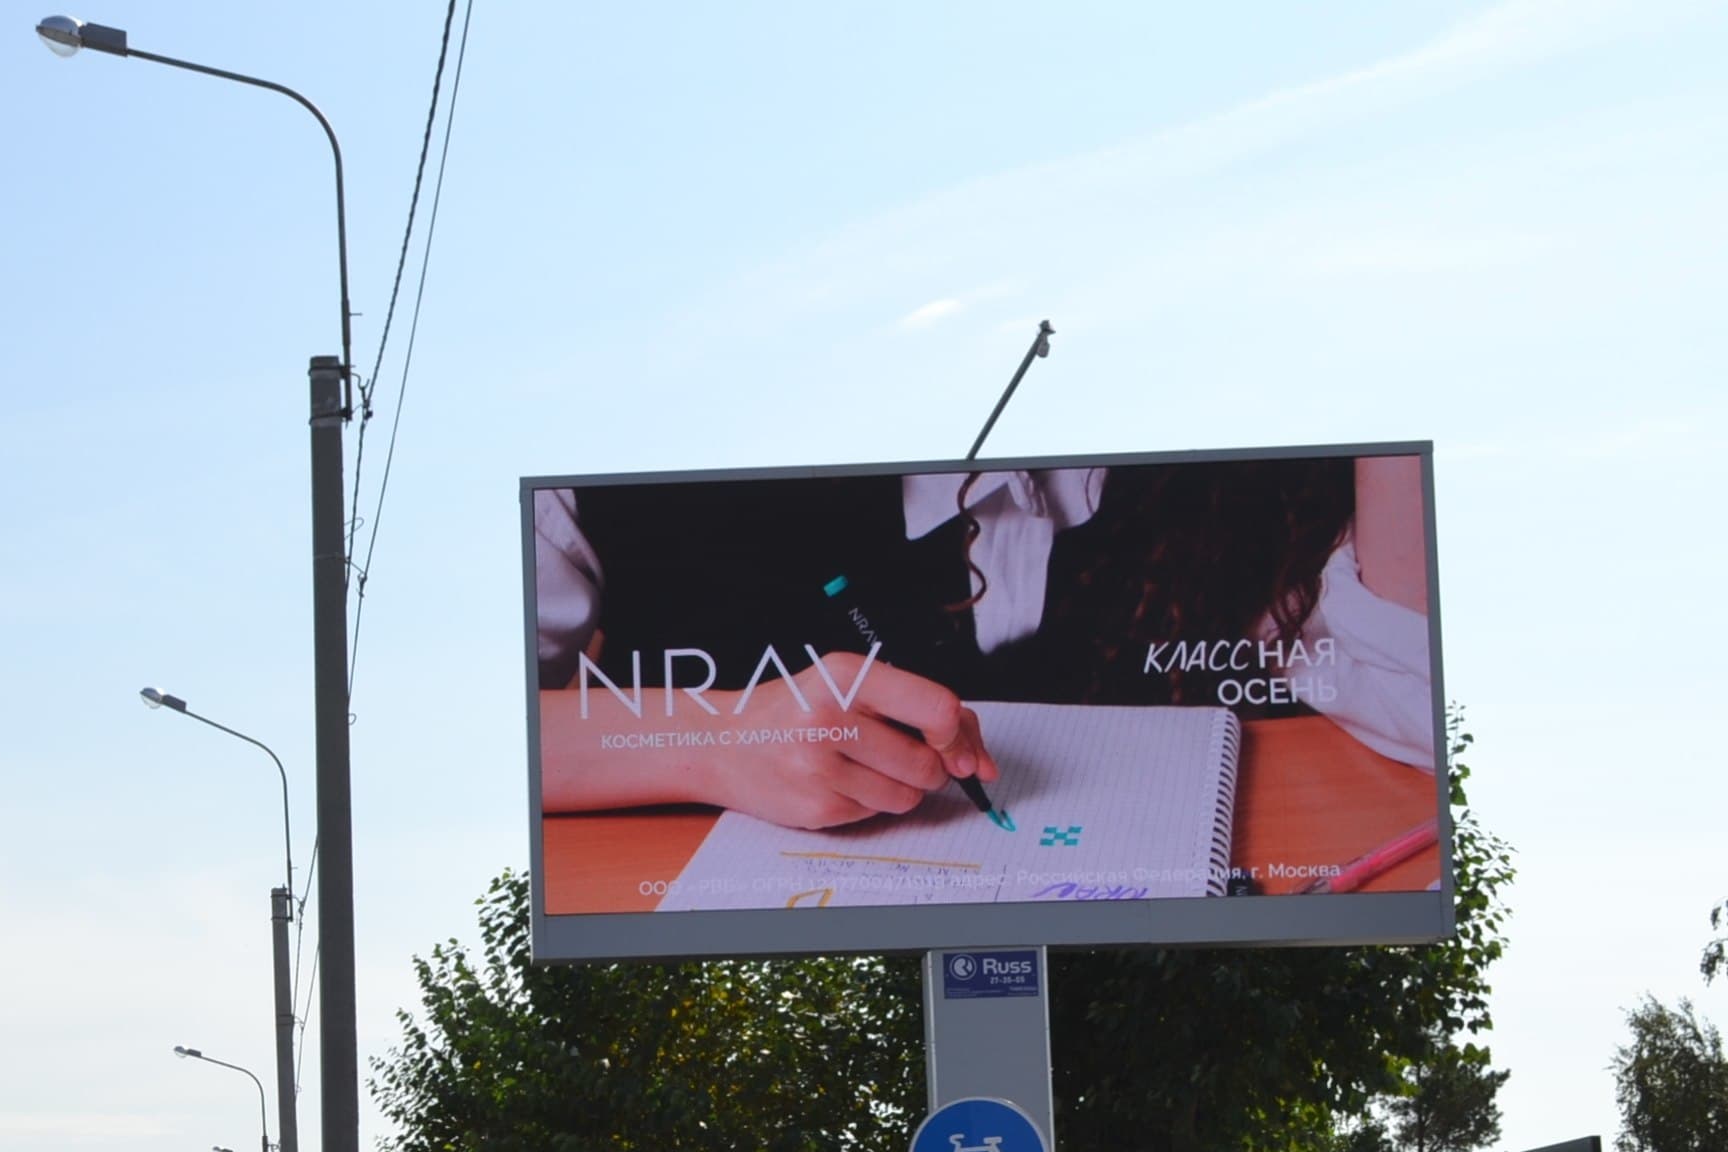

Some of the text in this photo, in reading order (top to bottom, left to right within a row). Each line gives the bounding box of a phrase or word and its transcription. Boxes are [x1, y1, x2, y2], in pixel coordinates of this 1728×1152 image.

[1143, 637, 1336, 674] КЛАССНАЯ
[578, 640, 883, 720] NRAV
[1217, 676, 1338, 705] ОСЕНЬ
[600, 726, 860, 750] КОСМЕТИКА С ХАРАКТЕРОМ
[1015, 868, 1130, 887] Российская
[1267, 862, 1341, 881] Москва
[982, 957, 1032, 975] Russ
